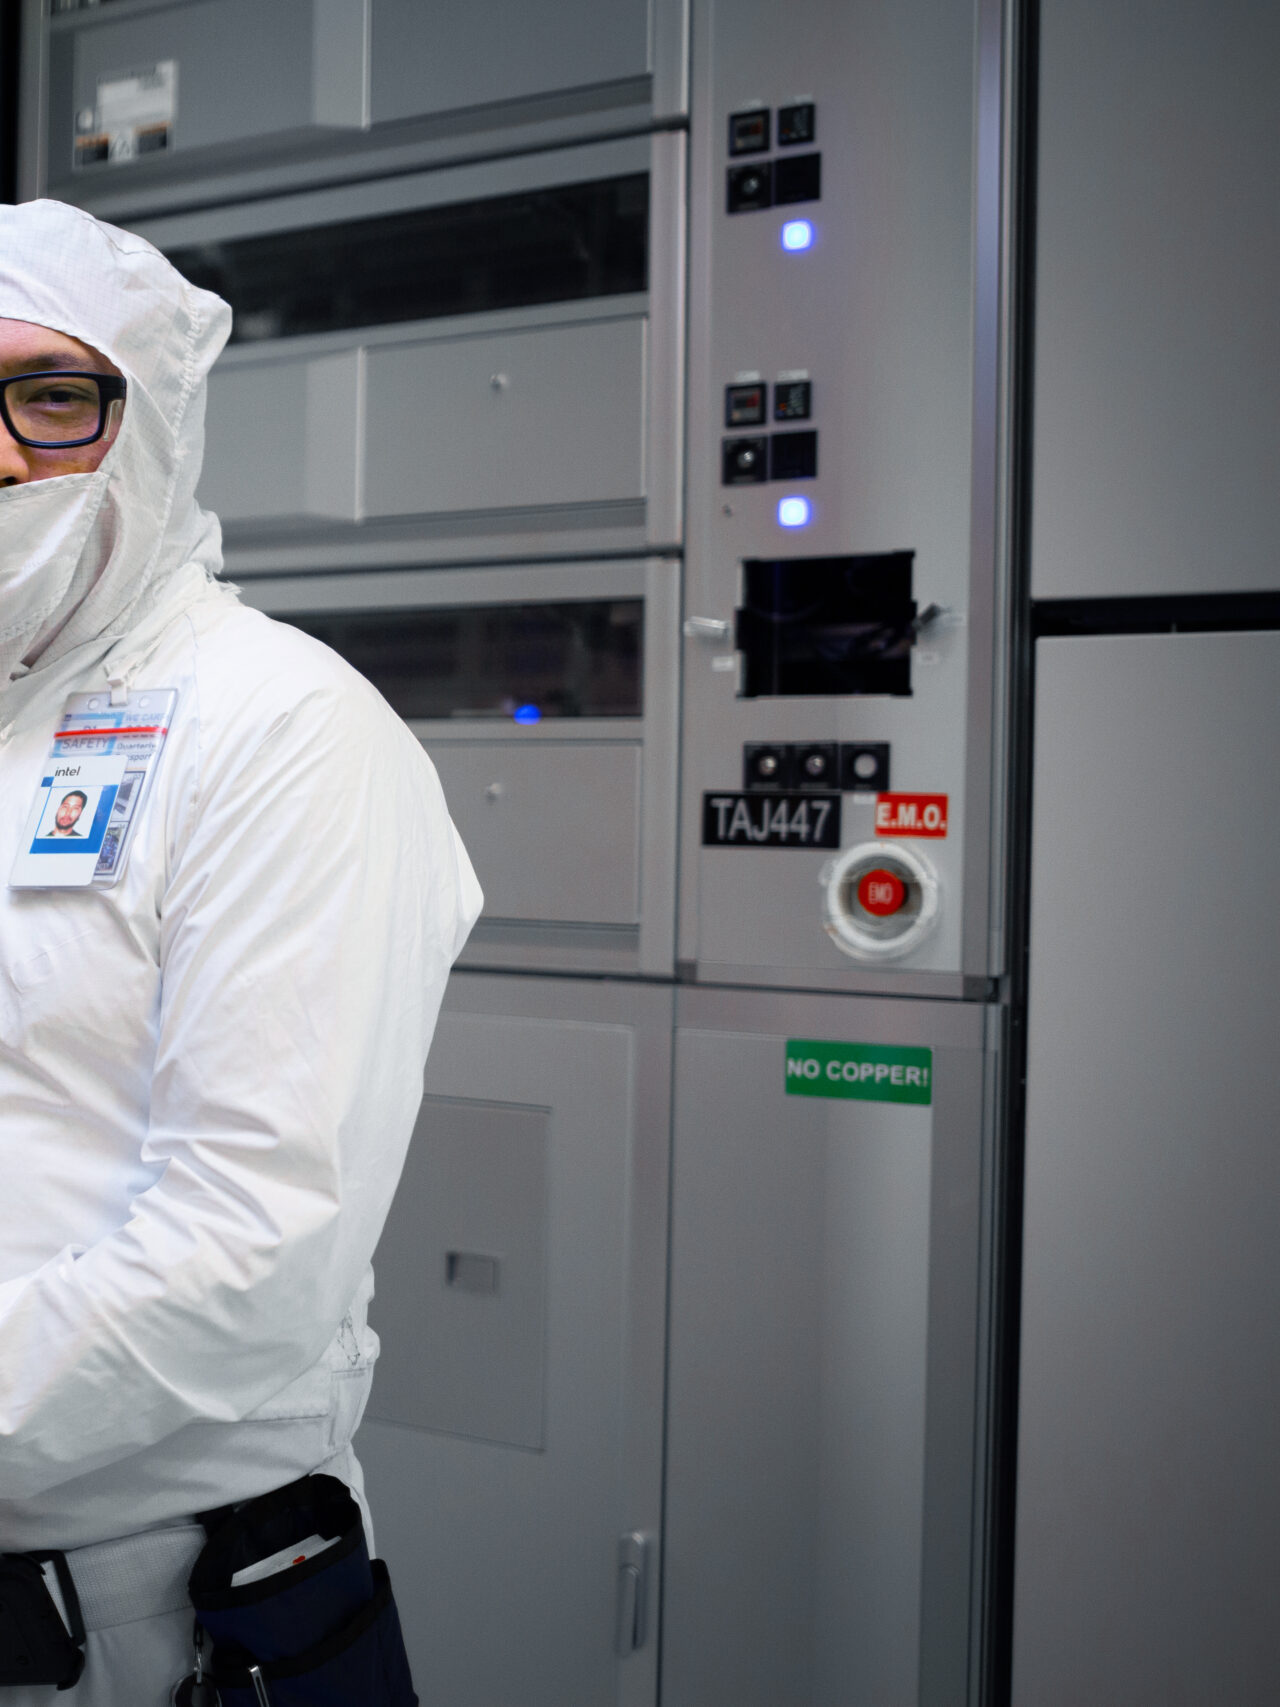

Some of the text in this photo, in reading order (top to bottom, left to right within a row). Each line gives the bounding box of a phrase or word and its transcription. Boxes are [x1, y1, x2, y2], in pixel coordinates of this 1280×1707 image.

[61, 737, 109, 751] SAFETY
[55, 766, 81, 777] intel
[710, 797, 832, 842] TAJ447
[876, 801, 947, 831] E.M.O.
[786, 1057, 929, 1088] NO COPPER!
